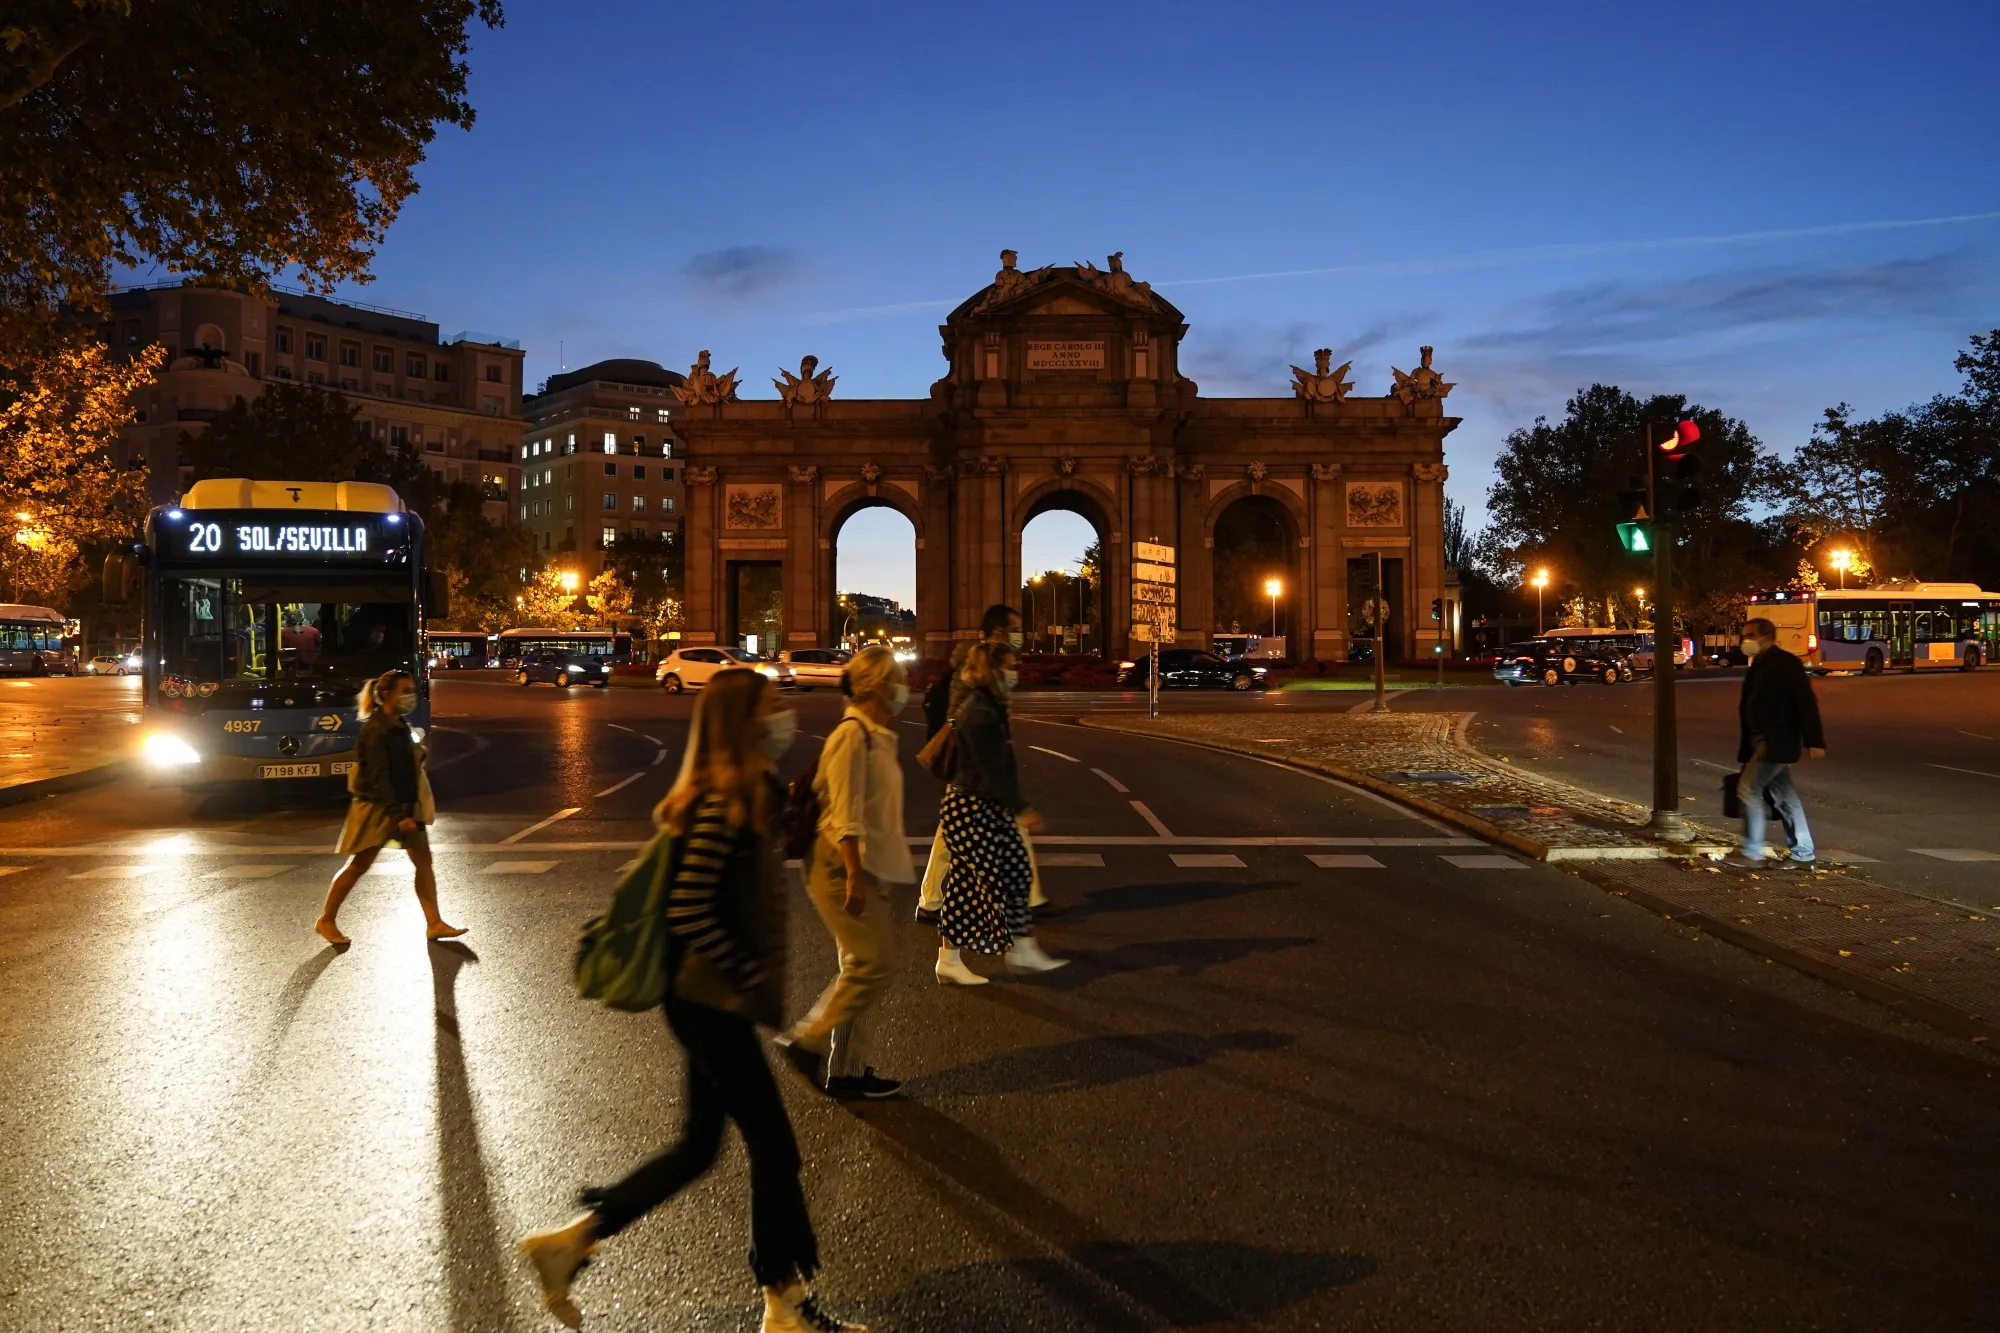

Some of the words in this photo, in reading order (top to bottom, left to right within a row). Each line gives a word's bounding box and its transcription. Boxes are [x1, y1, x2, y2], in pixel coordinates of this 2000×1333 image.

[1027, 343, 1051, 351] REGE
[1054, 343, 1092, 351] CAROLO
[190, 523, 221, 552] 20
[240, 526, 367, 552] SOL/SEVILLA
[223, 720, 262, 733] 4937
[266, 766, 294, 777] 7198
[297, 765, 318, 776] KFX
